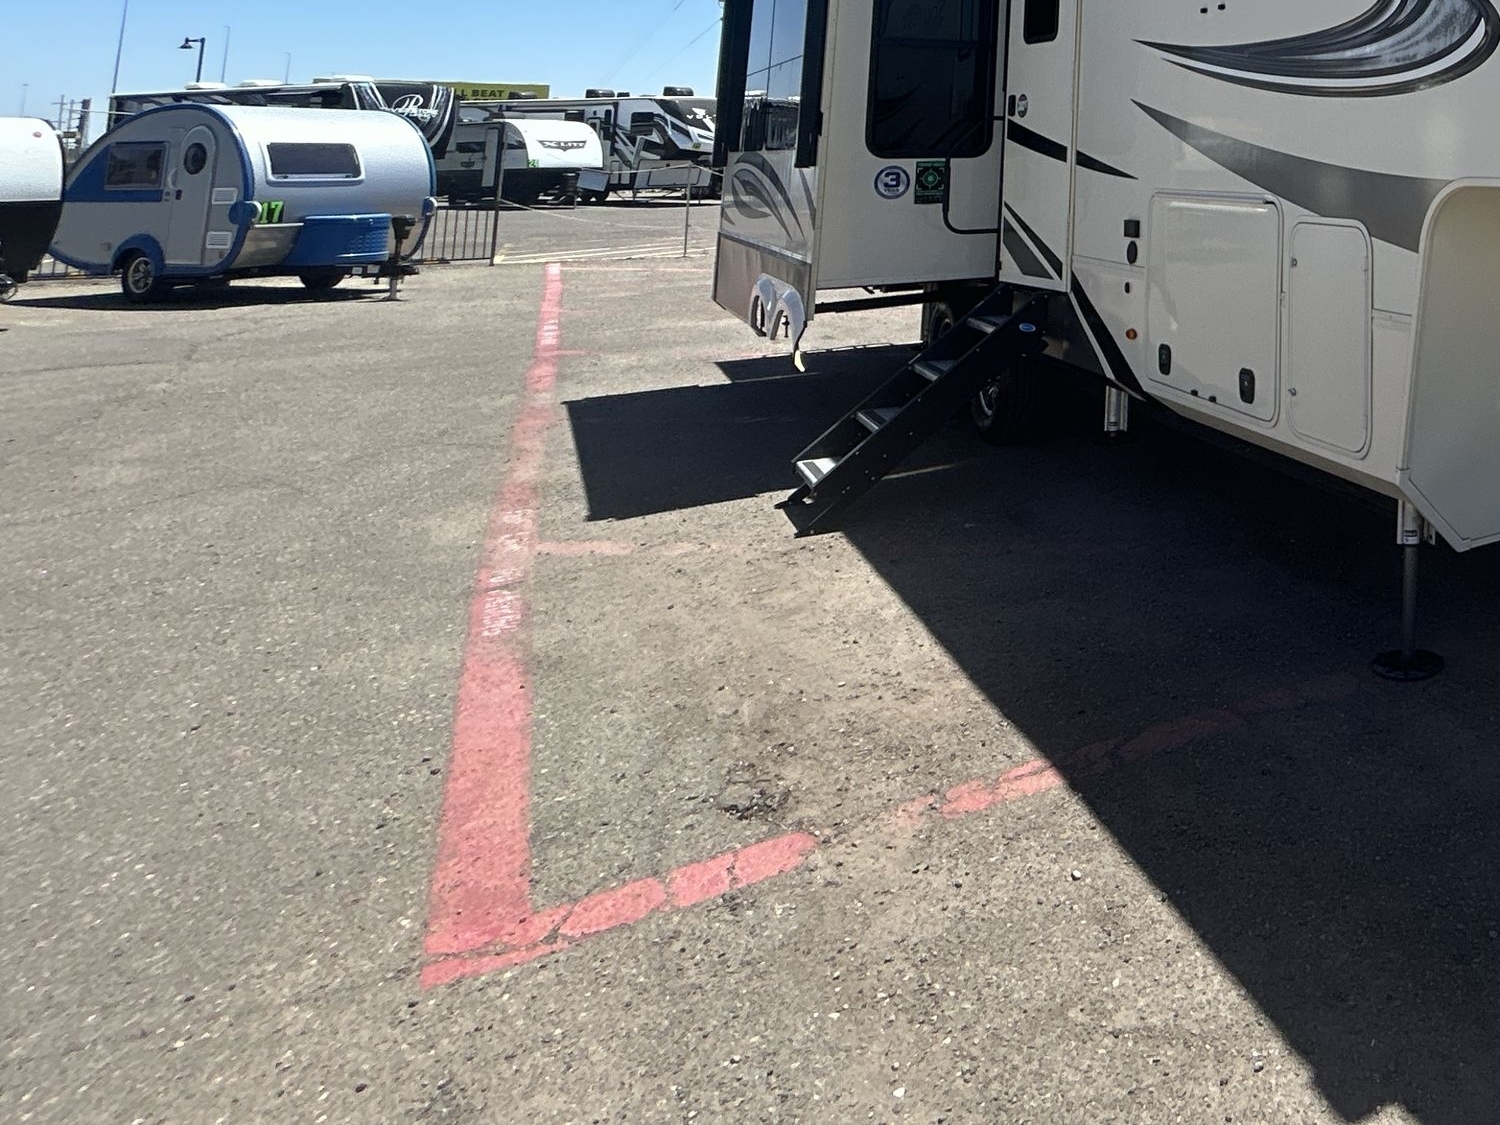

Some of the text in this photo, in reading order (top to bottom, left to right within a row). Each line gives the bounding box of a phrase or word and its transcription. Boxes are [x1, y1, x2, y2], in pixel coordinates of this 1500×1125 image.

[472, 89, 505, 98] BEAT
[883, 171, 901, 188] 3
[260, 201, 284, 223] 17
